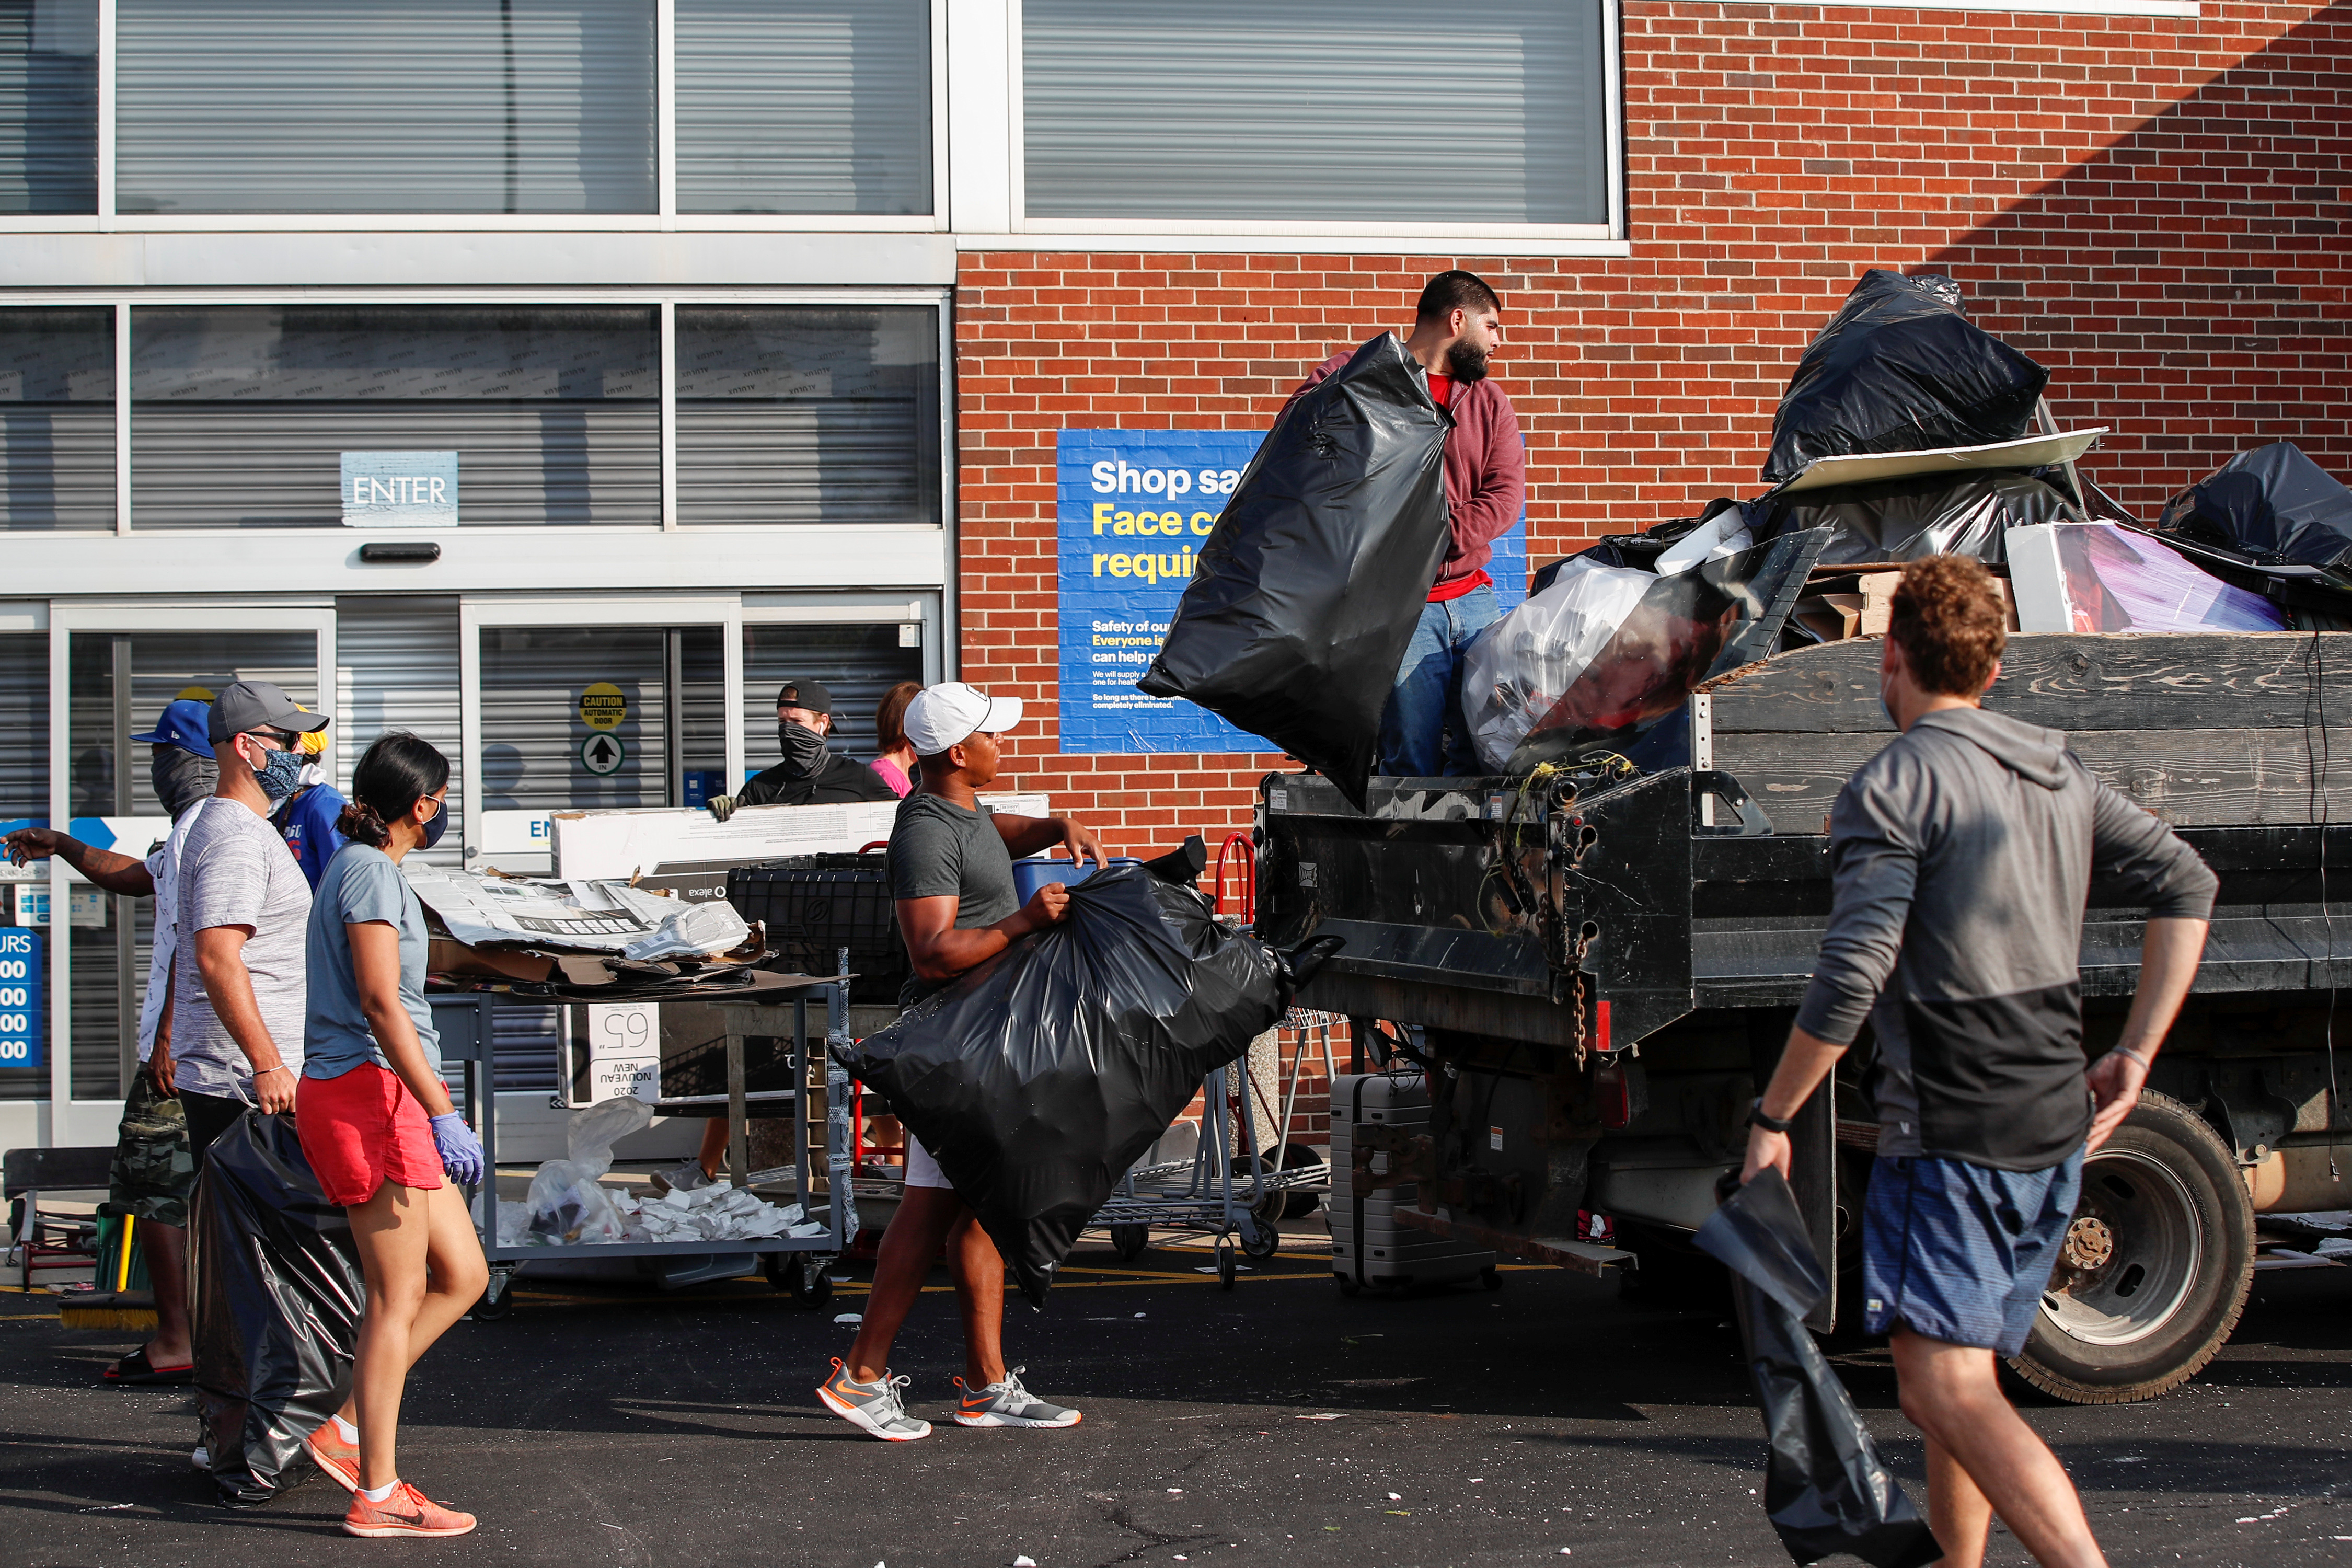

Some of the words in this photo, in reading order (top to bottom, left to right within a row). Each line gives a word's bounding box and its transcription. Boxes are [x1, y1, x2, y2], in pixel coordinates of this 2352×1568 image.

[1092, 460, 1191, 500] Shop
[353, 477, 446, 504] ENTER
[1093, 503, 1183, 536] Face
[1092, 620, 1134, 634] Safety
[1135, 620, 1149, 632] of
[1092, 635, 1152, 648] Everyone
[1154, 635, 1165, 645] is
[1092, 653, 1116, 663] can
[1118, 651, 1147, 664] help
[1148, 653, 1159, 664] p
[1117, 671, 1140, 679] supply
[584, 697, 622, 706] CAUTION
[1103, 694, 1120, 702] long
[688, 888, 712, 898] alexa
[599, 1013, 648, 1050] 65"
[613, 1063, 638, 1073] NEW
[600, 1072, 651, 1083] NOUVEAU
[614, 1087, 639, 1096] 2020
